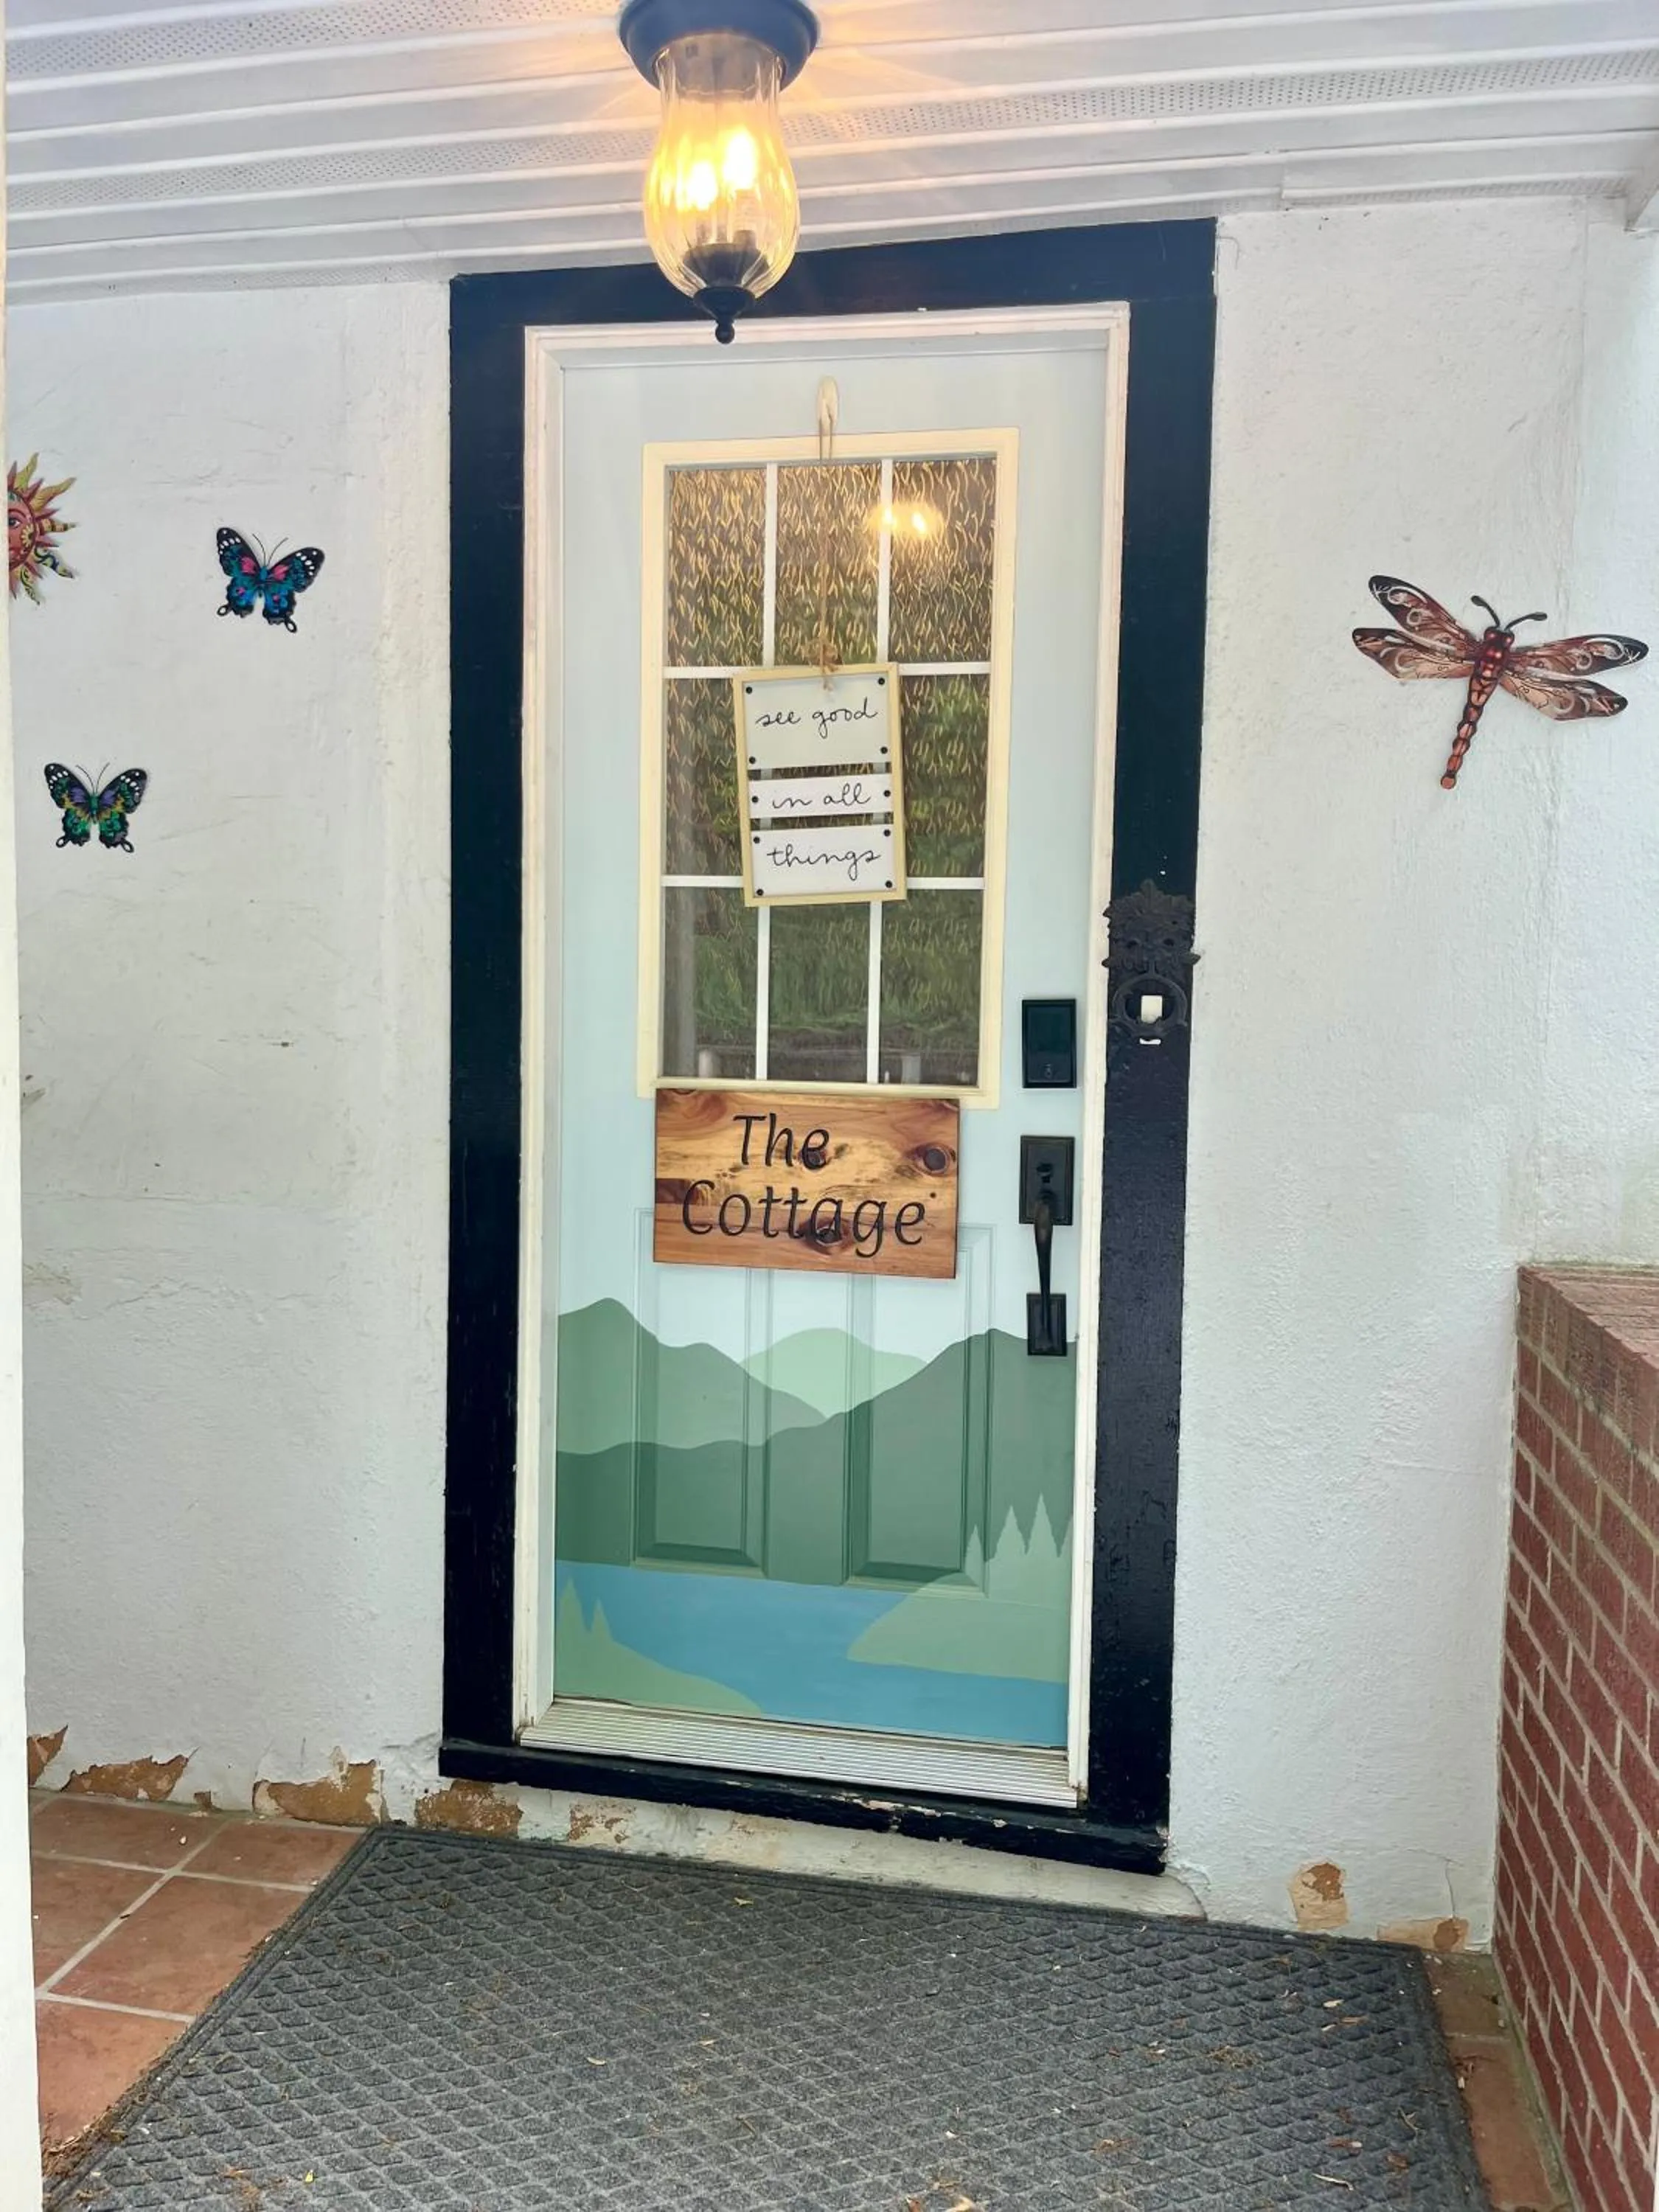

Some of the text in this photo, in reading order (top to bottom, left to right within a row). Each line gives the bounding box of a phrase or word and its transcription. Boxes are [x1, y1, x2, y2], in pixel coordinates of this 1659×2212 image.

[755, 697, 879, 739] see good
[772, 782, 872, 809] in all
[766, 844, 881, 880] things
[733, 1112, 830, 1170] The
[681, 1179, 927, 1258] Cottage
